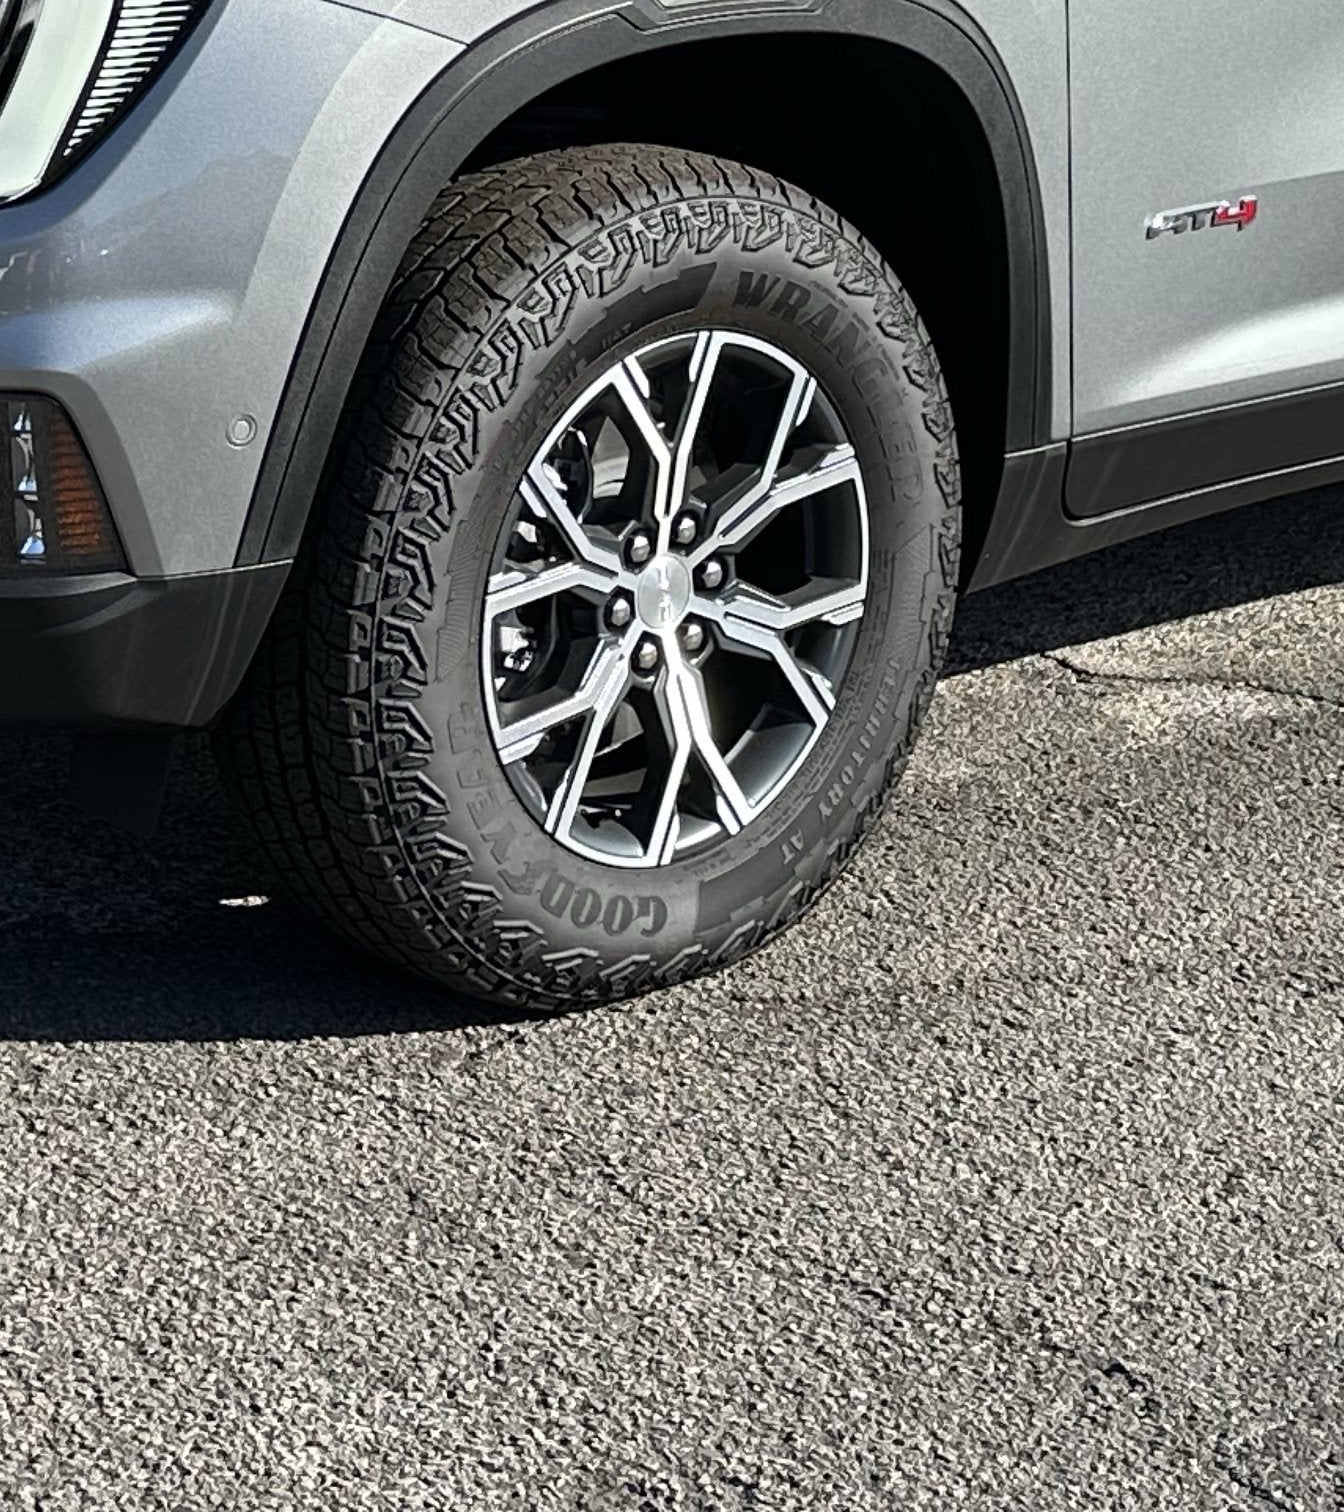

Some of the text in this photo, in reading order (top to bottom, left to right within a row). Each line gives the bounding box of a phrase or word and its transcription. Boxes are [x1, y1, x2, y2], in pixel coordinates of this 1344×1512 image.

[1144, 194, 1259, 241] AT4
[731, 270, 925, 502] WRANGLER
[446, 699, 669, 937] GOODYEAR
[818, 656, 902, 824] TERRITORY
[780, 827, 805, 867] AT
